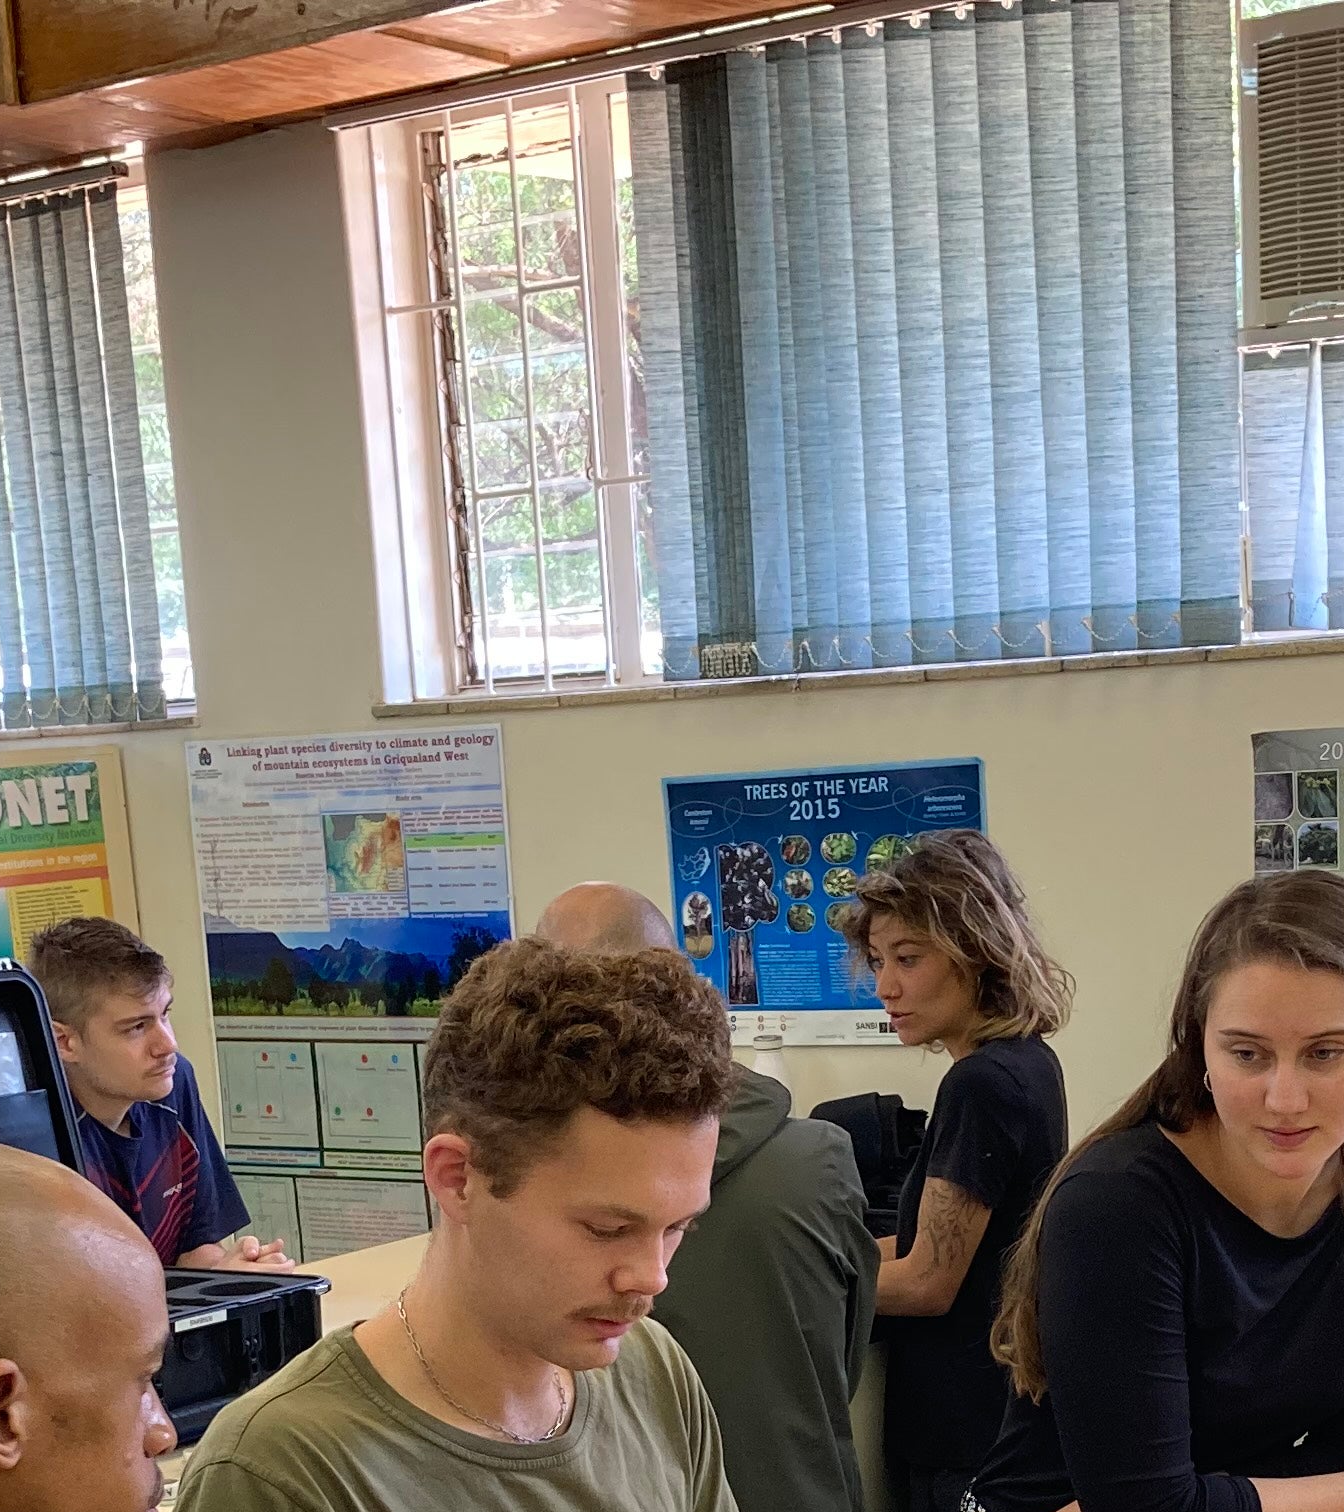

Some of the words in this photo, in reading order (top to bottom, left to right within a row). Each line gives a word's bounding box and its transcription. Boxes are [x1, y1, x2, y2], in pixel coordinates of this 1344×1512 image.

[226, 745, 262, 759] Linking
[264, 744, 289, 757] plant
[292, 743, 327, 756] species
[329, 739, 373, 753] diversity
[376, 740, 387, 749] to
[390, 737, 428, 748] climate
[431, 736, 451, 747] and
[454, 734, 494, 746] geology
[252, 760, 262, 771] of
[264, 759, 309, 771] mountain
[313, 757, 368, 770] ecosystems
[371, 755, 382, 766] in
[384, 752, 439, 768] Griqualand
[444, 751, 469, 761] West
[744, 784, 788, 801] TREES
[791, 782, 811, 798] OF
[814, 779, 846, 798] THE
[849, 776, 889, 794] YEAR
[789, 797, 841, 822] 2015
[11, 832, 55, 844] Diversity
[57, 827, 97, 839] Network
[46, 856, 55, 866] in
[57, 854, 71, 864] the
[73, 853, 98, 865] region
[856, 1022, 877, 1030] SANBI
